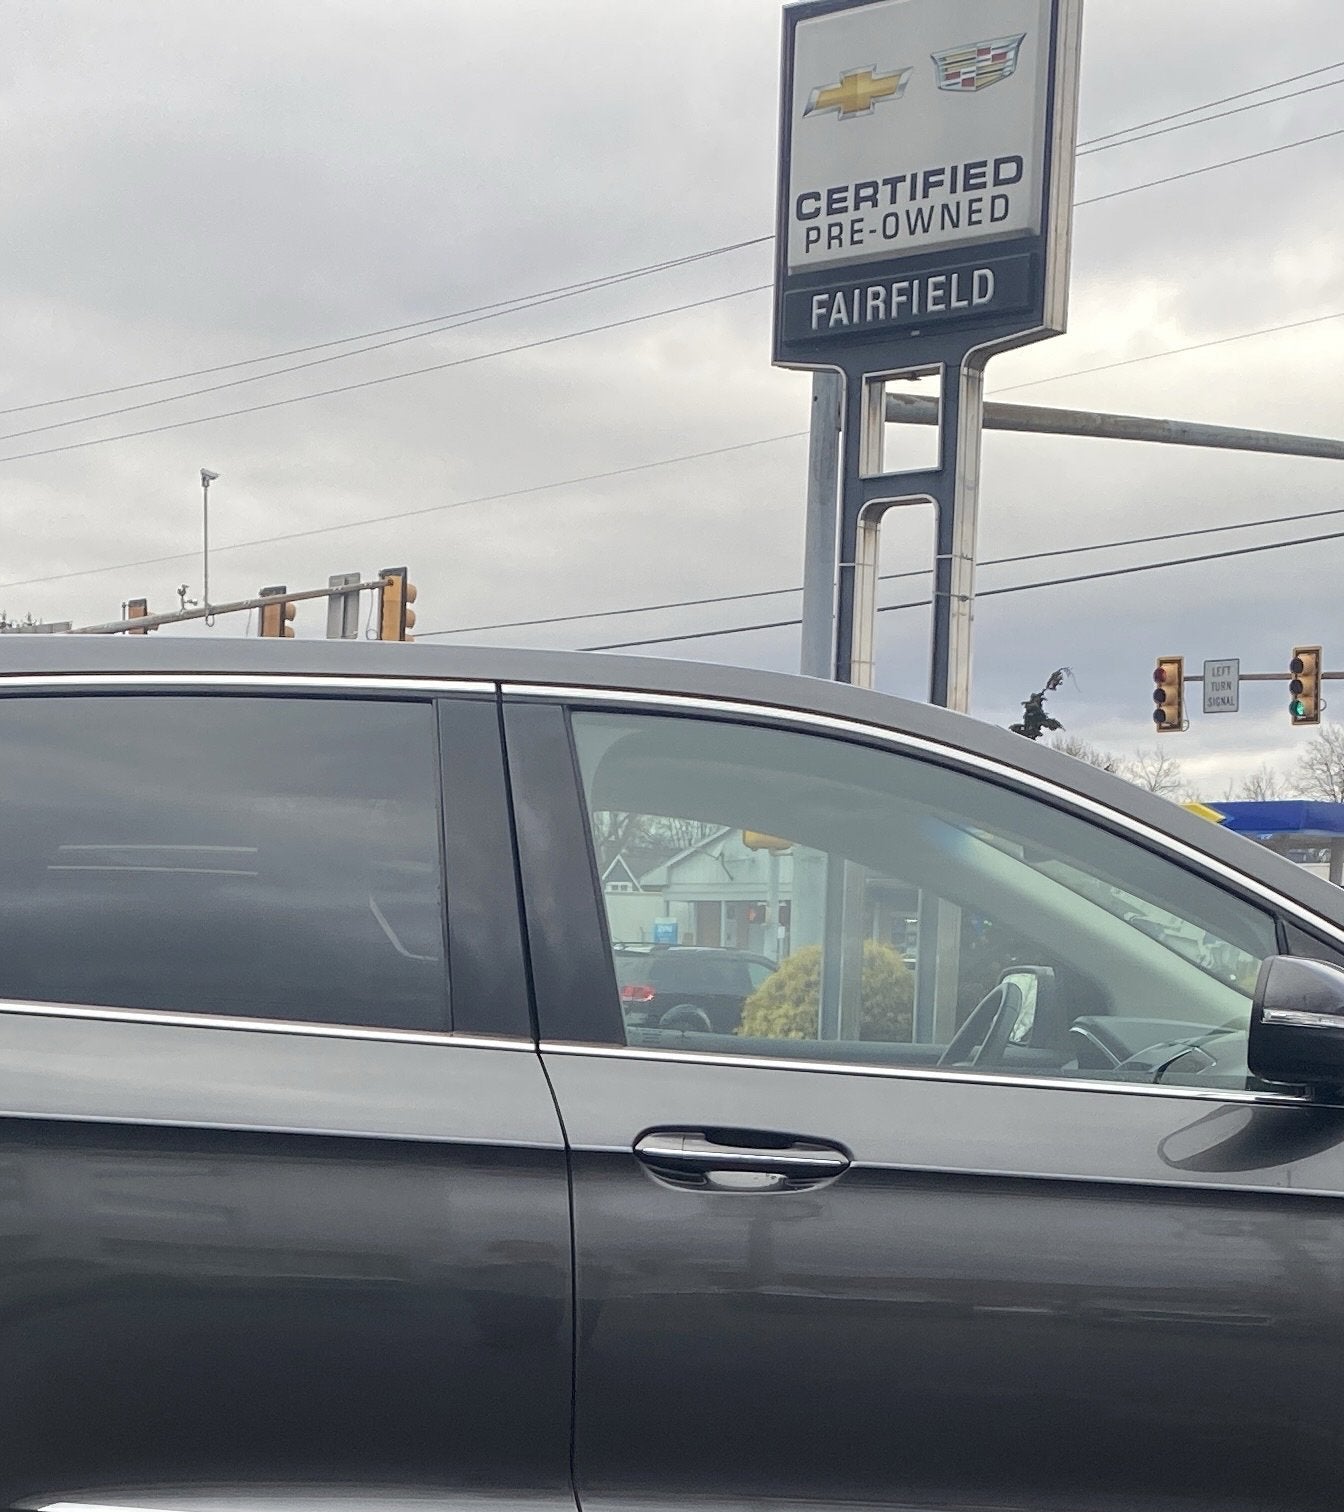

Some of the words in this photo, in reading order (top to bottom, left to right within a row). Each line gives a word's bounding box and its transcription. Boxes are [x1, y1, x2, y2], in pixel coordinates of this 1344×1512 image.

[796, 155, 1024, 222] CERTIFIED
[805, 193, 1009, 253] PRE-OWNED
[811, 268, 996, 330] FAIRFIELD
[1211, 665, 1231, 677] LEFT
[1211, 681, 1232, 692] TURN
[1207, 696, 1235, 707] SIGNAL
